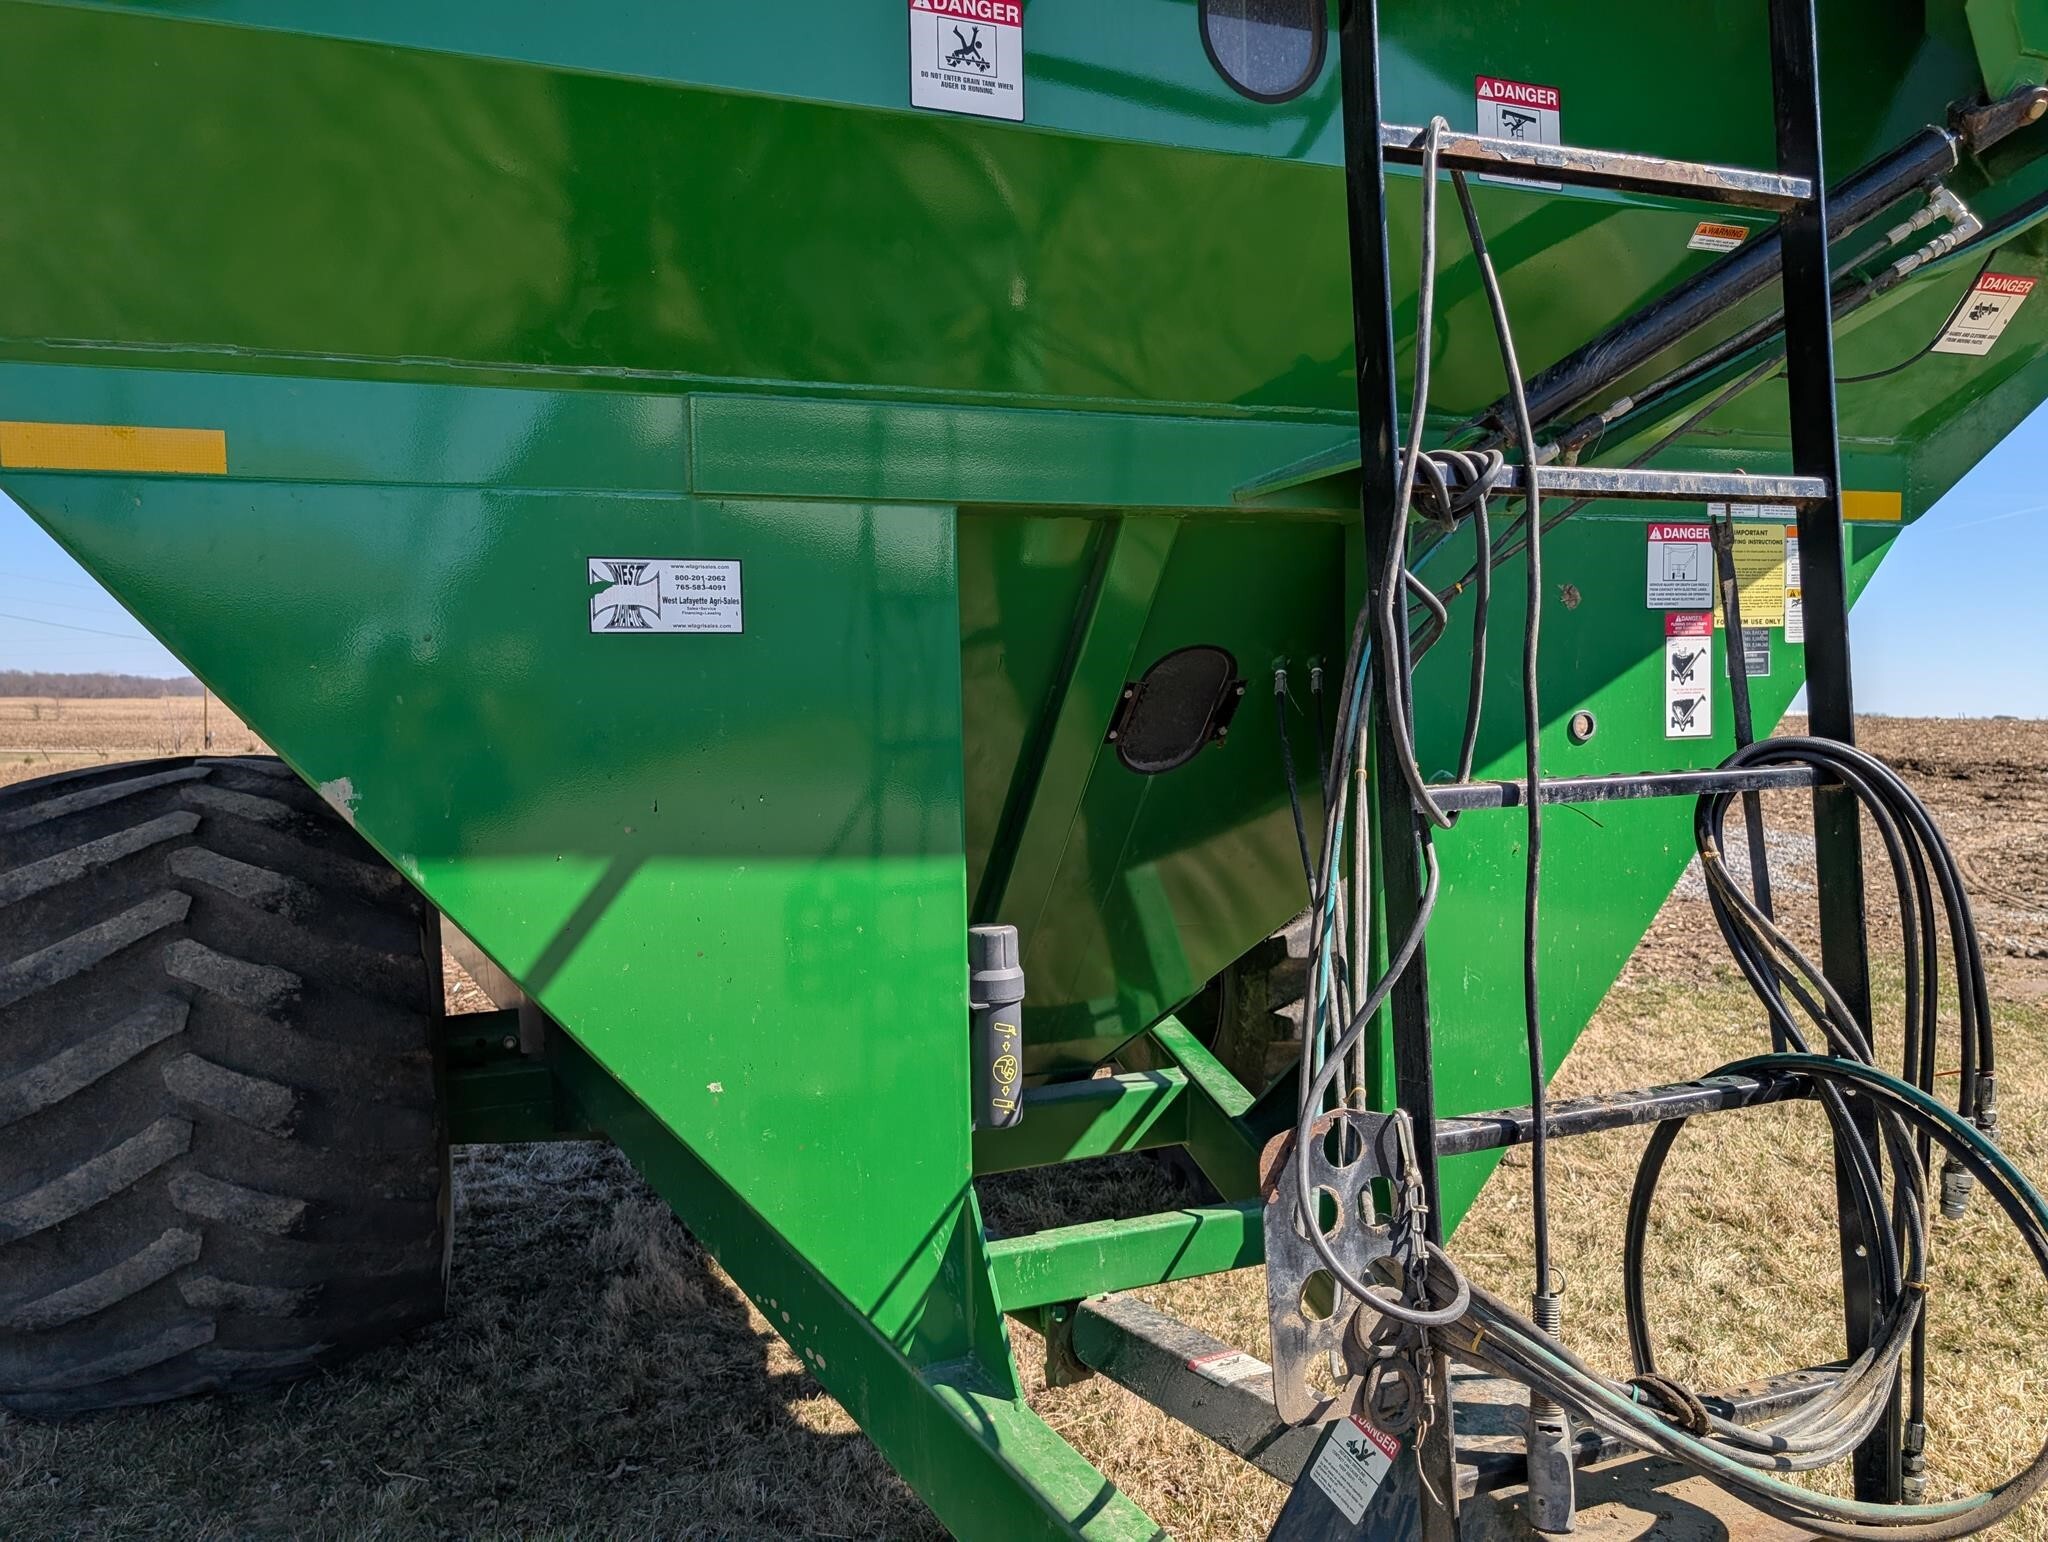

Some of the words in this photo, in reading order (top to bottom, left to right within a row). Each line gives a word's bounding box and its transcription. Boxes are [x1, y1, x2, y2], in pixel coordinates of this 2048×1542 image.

[933, 0, 1019, 23] DANGER
[941, 81, 958, 89] AUGER
[944, 74, 961, 82] ENTER
[963, 77, 980, 85] GRAIN
[998, 82, 1013, 90] WHEN
[1494, 82, 1557, 105] DANGER
[1708, 226, 1744, 238] WARNING
[1983, 277, 2033, 292] DANGER
[1664, 528, 1710, 539] DANGER
[610, 565, 644, 585] WEST
[679, 597, 707, 606] Lafayette
[710, 597, 740, 606] Agri-Sales
[1359, 1417, 1397, 1454] DANGER
